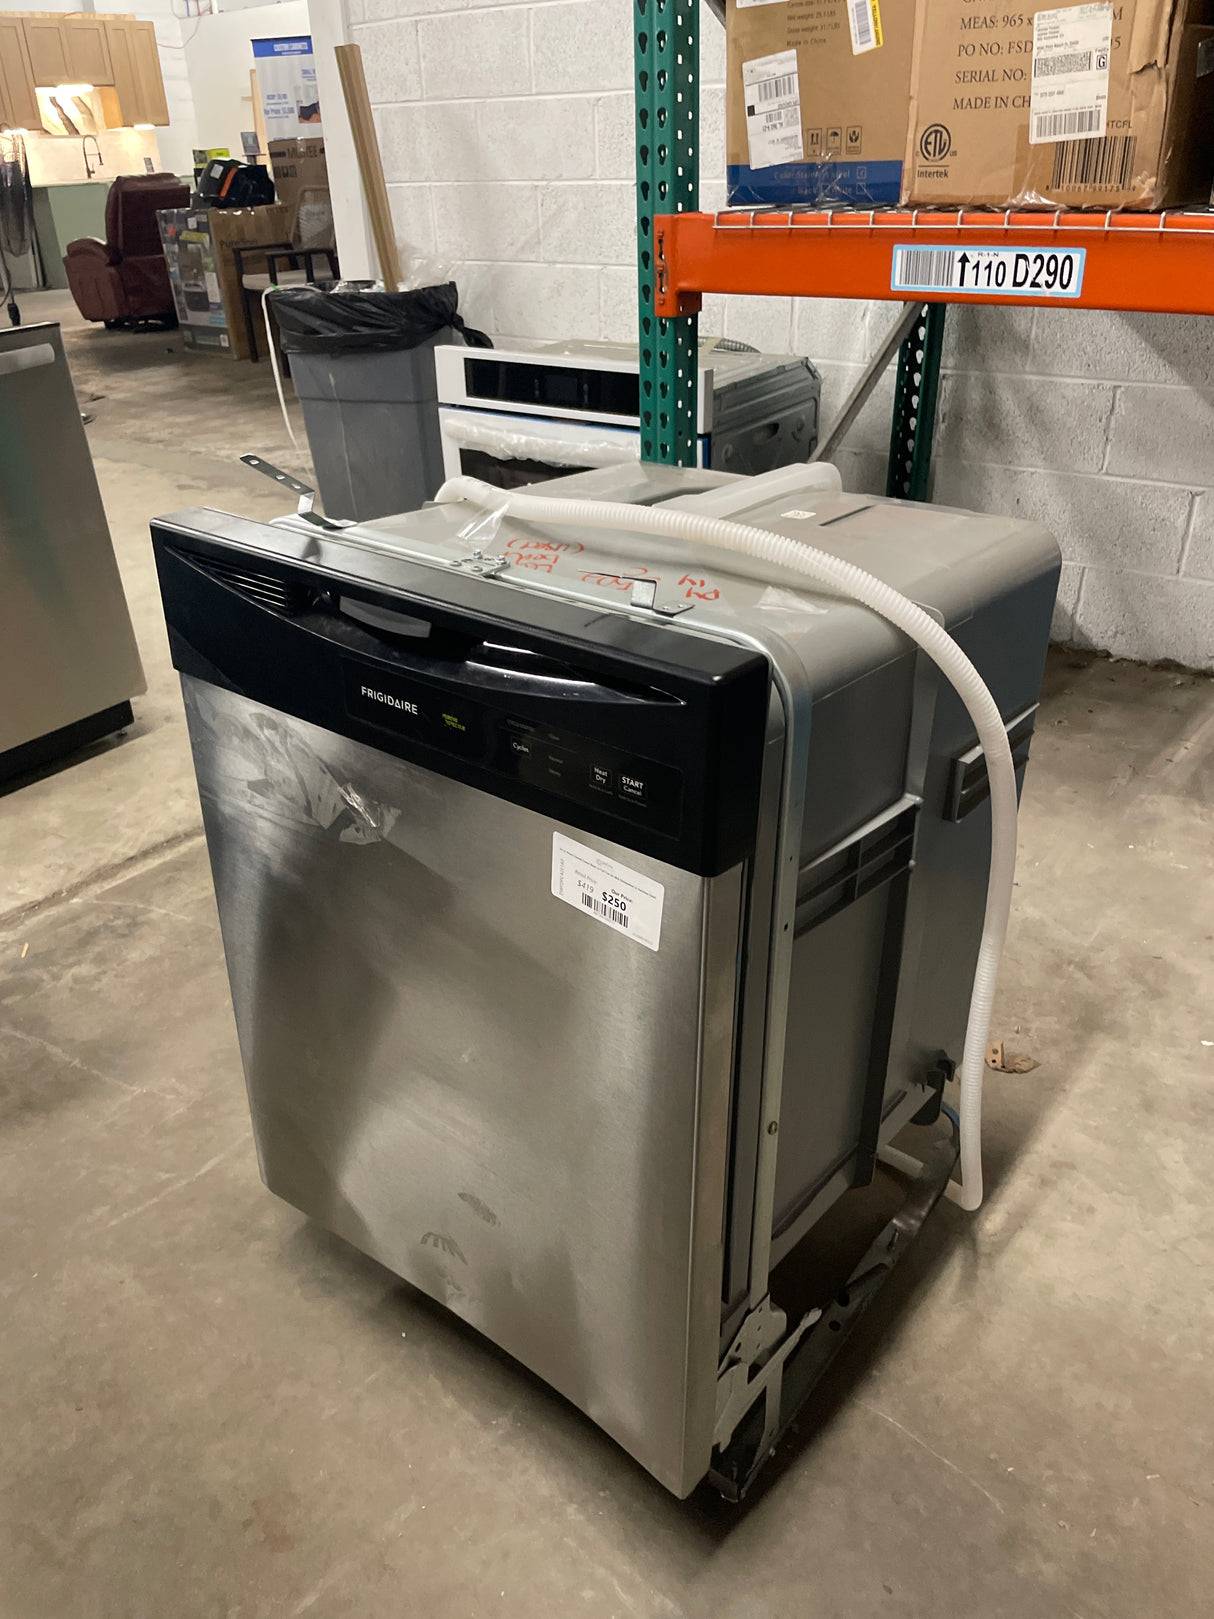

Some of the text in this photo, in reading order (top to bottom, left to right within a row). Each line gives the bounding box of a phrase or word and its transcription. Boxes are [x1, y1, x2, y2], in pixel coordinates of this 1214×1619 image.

[960, 15, 999, 30] MEAS:
[1002, 14, 1024, 28] 965
[958, 43, 976, 58] PO
[979, 41, 1004, 57] NO:
[955, 67, 1027, 84] SERIAL NO:
[953, 96, 991, 110] MADE
[995, 95, 1010, 109] IN
[917, 169, 949, 179] Intertek
[971, 253, 1074, 290] 110 D290
[361, 685, 418, 715] FRIGIDAIRE
[595, 774, 606, 785] Dry
[621, 776, 644, 790] START
[623, 785, 642, 796] Cancel
[577, 880, 594, 893] $419
[601, 891, 627, 912] $250
